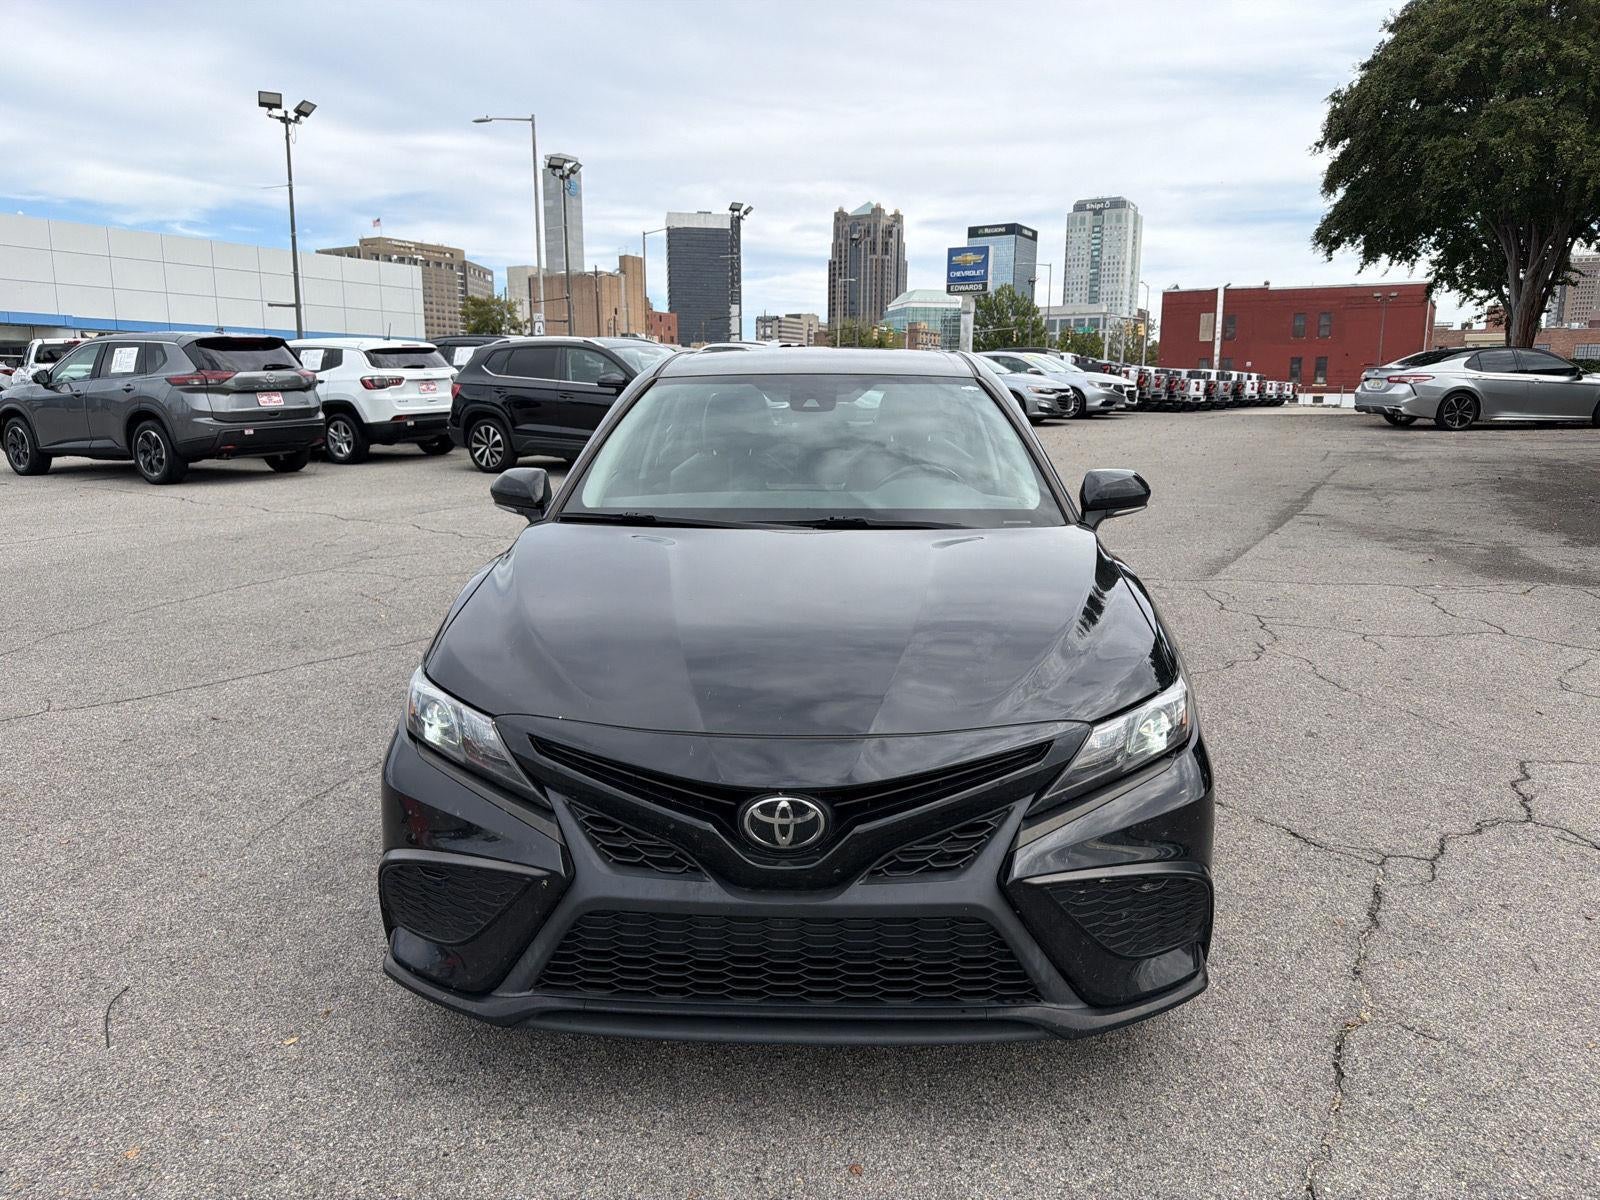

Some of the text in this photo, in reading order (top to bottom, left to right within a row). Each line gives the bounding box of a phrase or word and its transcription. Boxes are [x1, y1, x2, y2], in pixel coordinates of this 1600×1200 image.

[1086, 202, 1104, 210] Shipt
[984, 226, 1006, 234] REGIONS
[950, 269, 985, 278] CHEVROLET
[950, 283, 983, 292] EDWARDS
